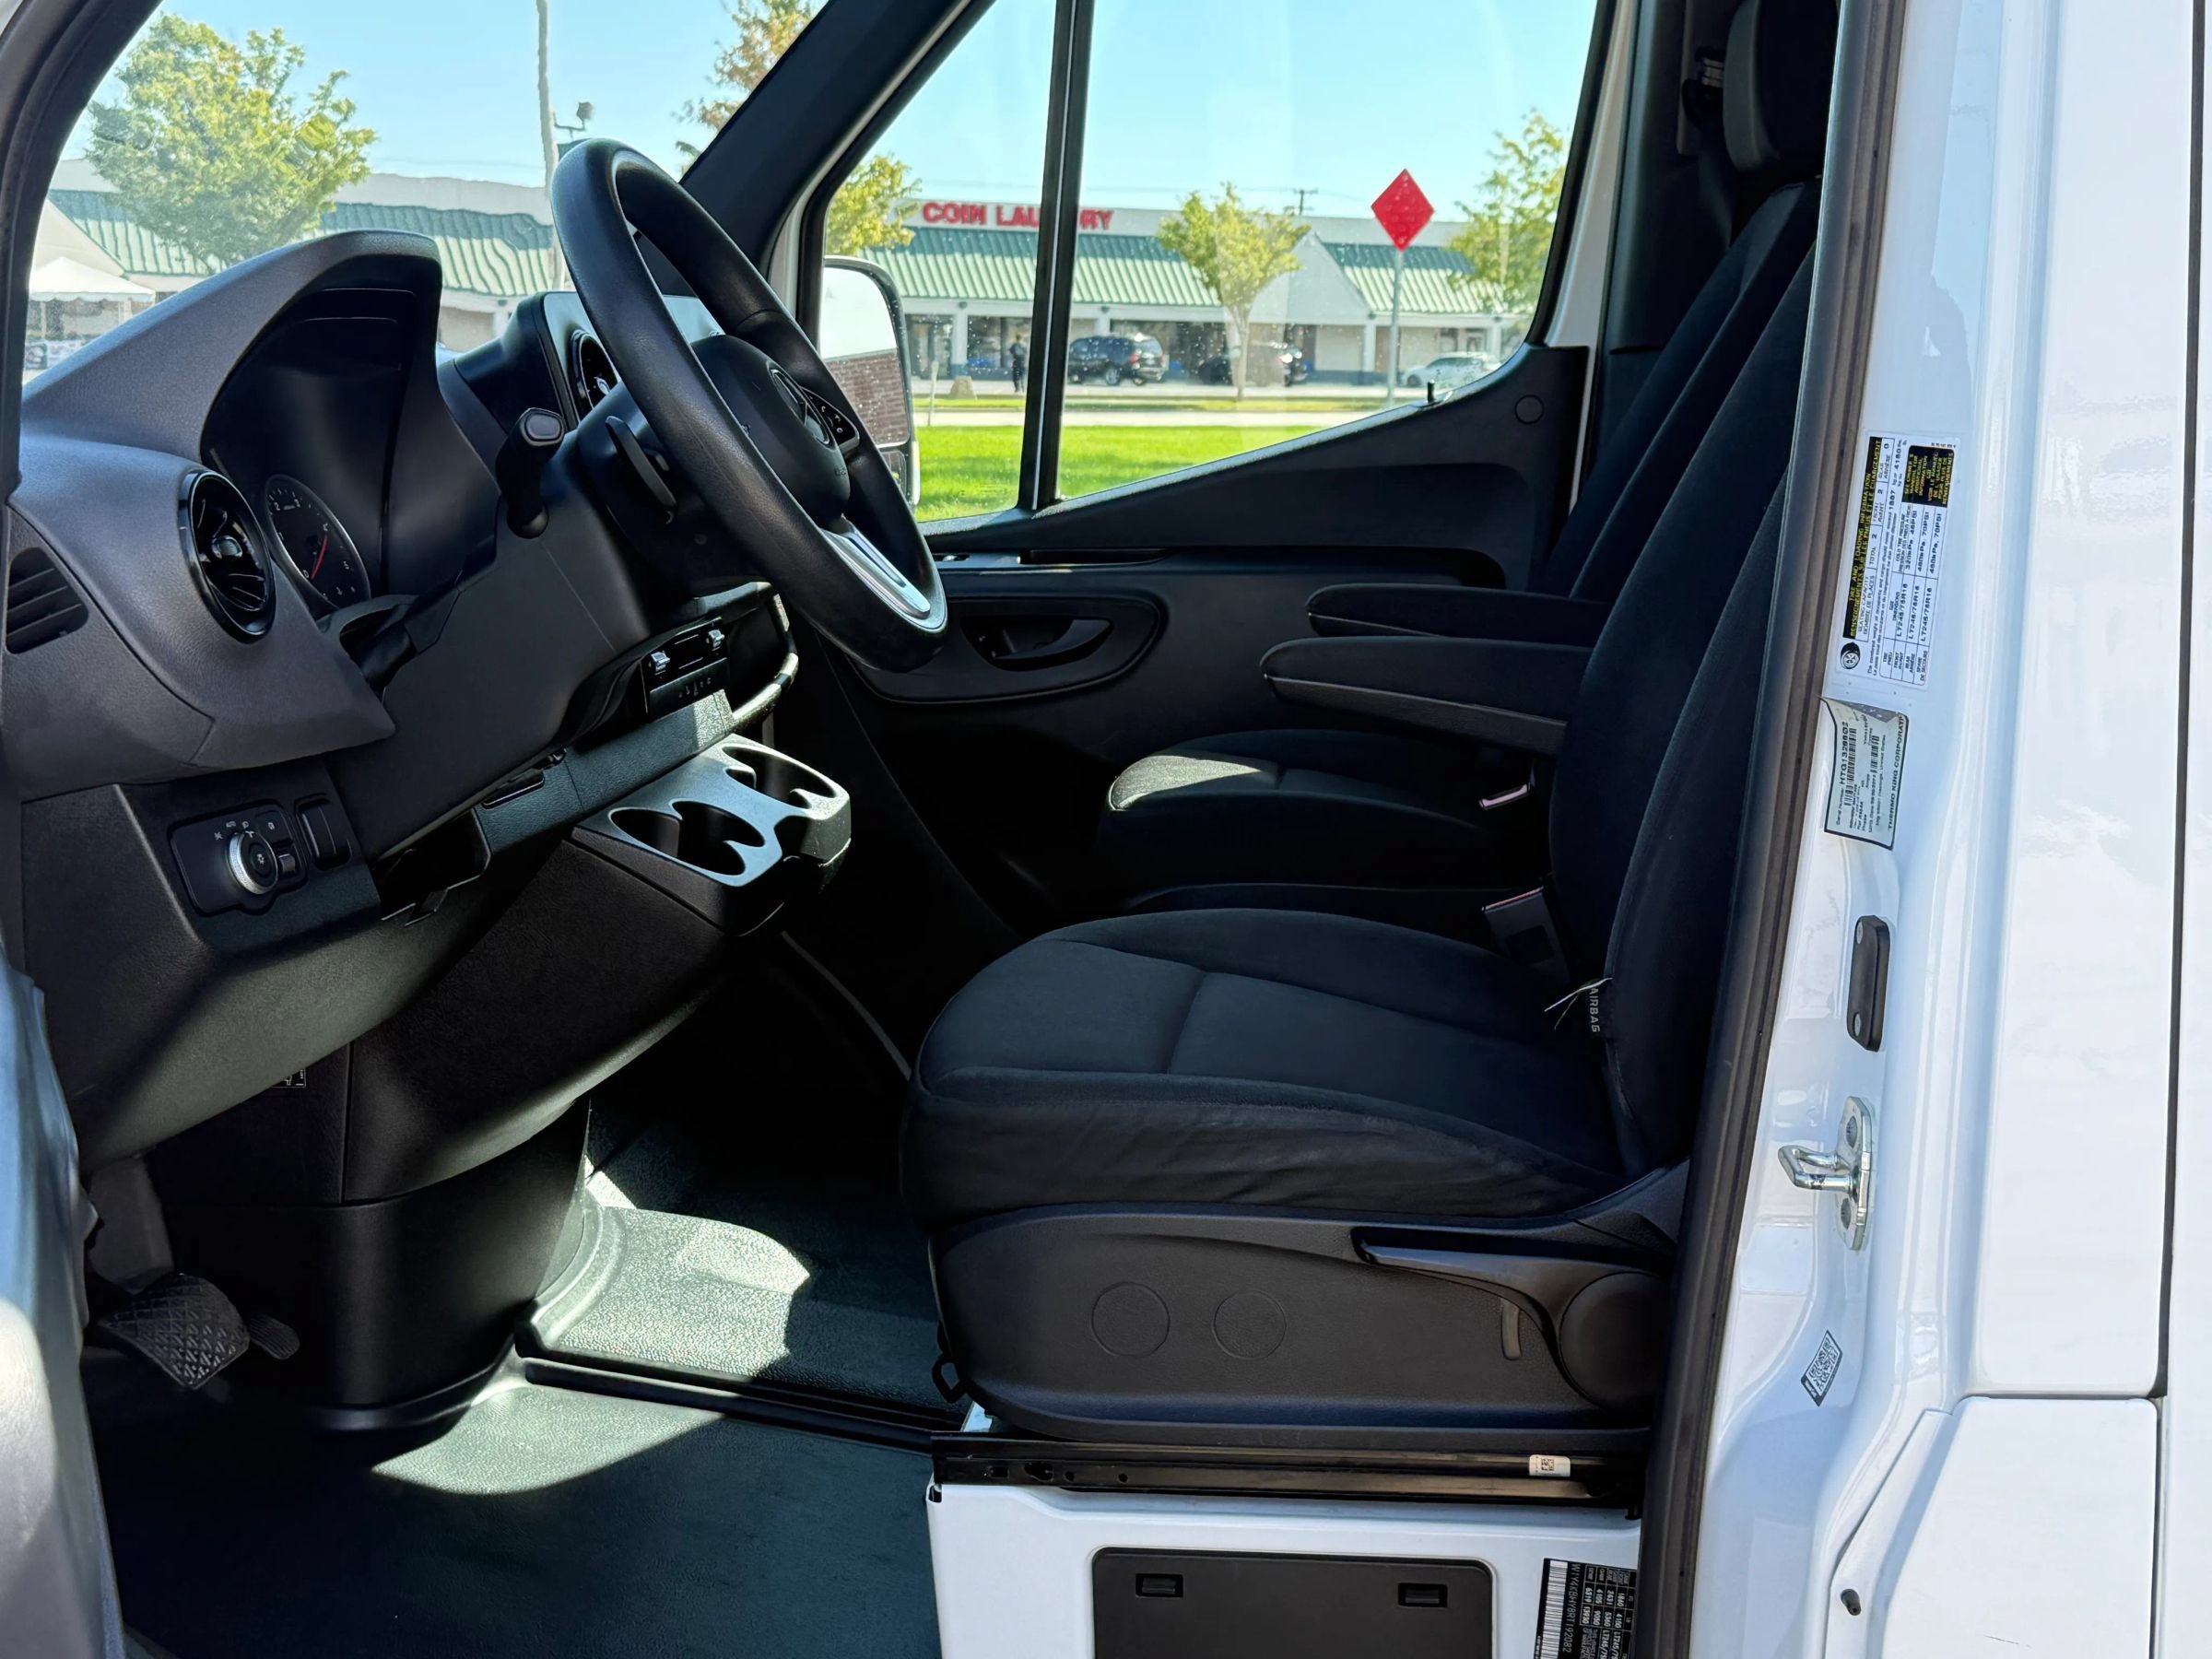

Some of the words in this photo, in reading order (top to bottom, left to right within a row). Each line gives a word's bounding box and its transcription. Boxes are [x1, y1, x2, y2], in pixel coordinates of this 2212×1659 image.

[923, 201, 986, 226] COIN
[996, 205, 1114, 229] LAURY
[1859, 472, 1871, 523] INFORMATION
[1888, 793, 1896, 830] THERMO
[1589, 988, 1601, 1032] AIRBAG
